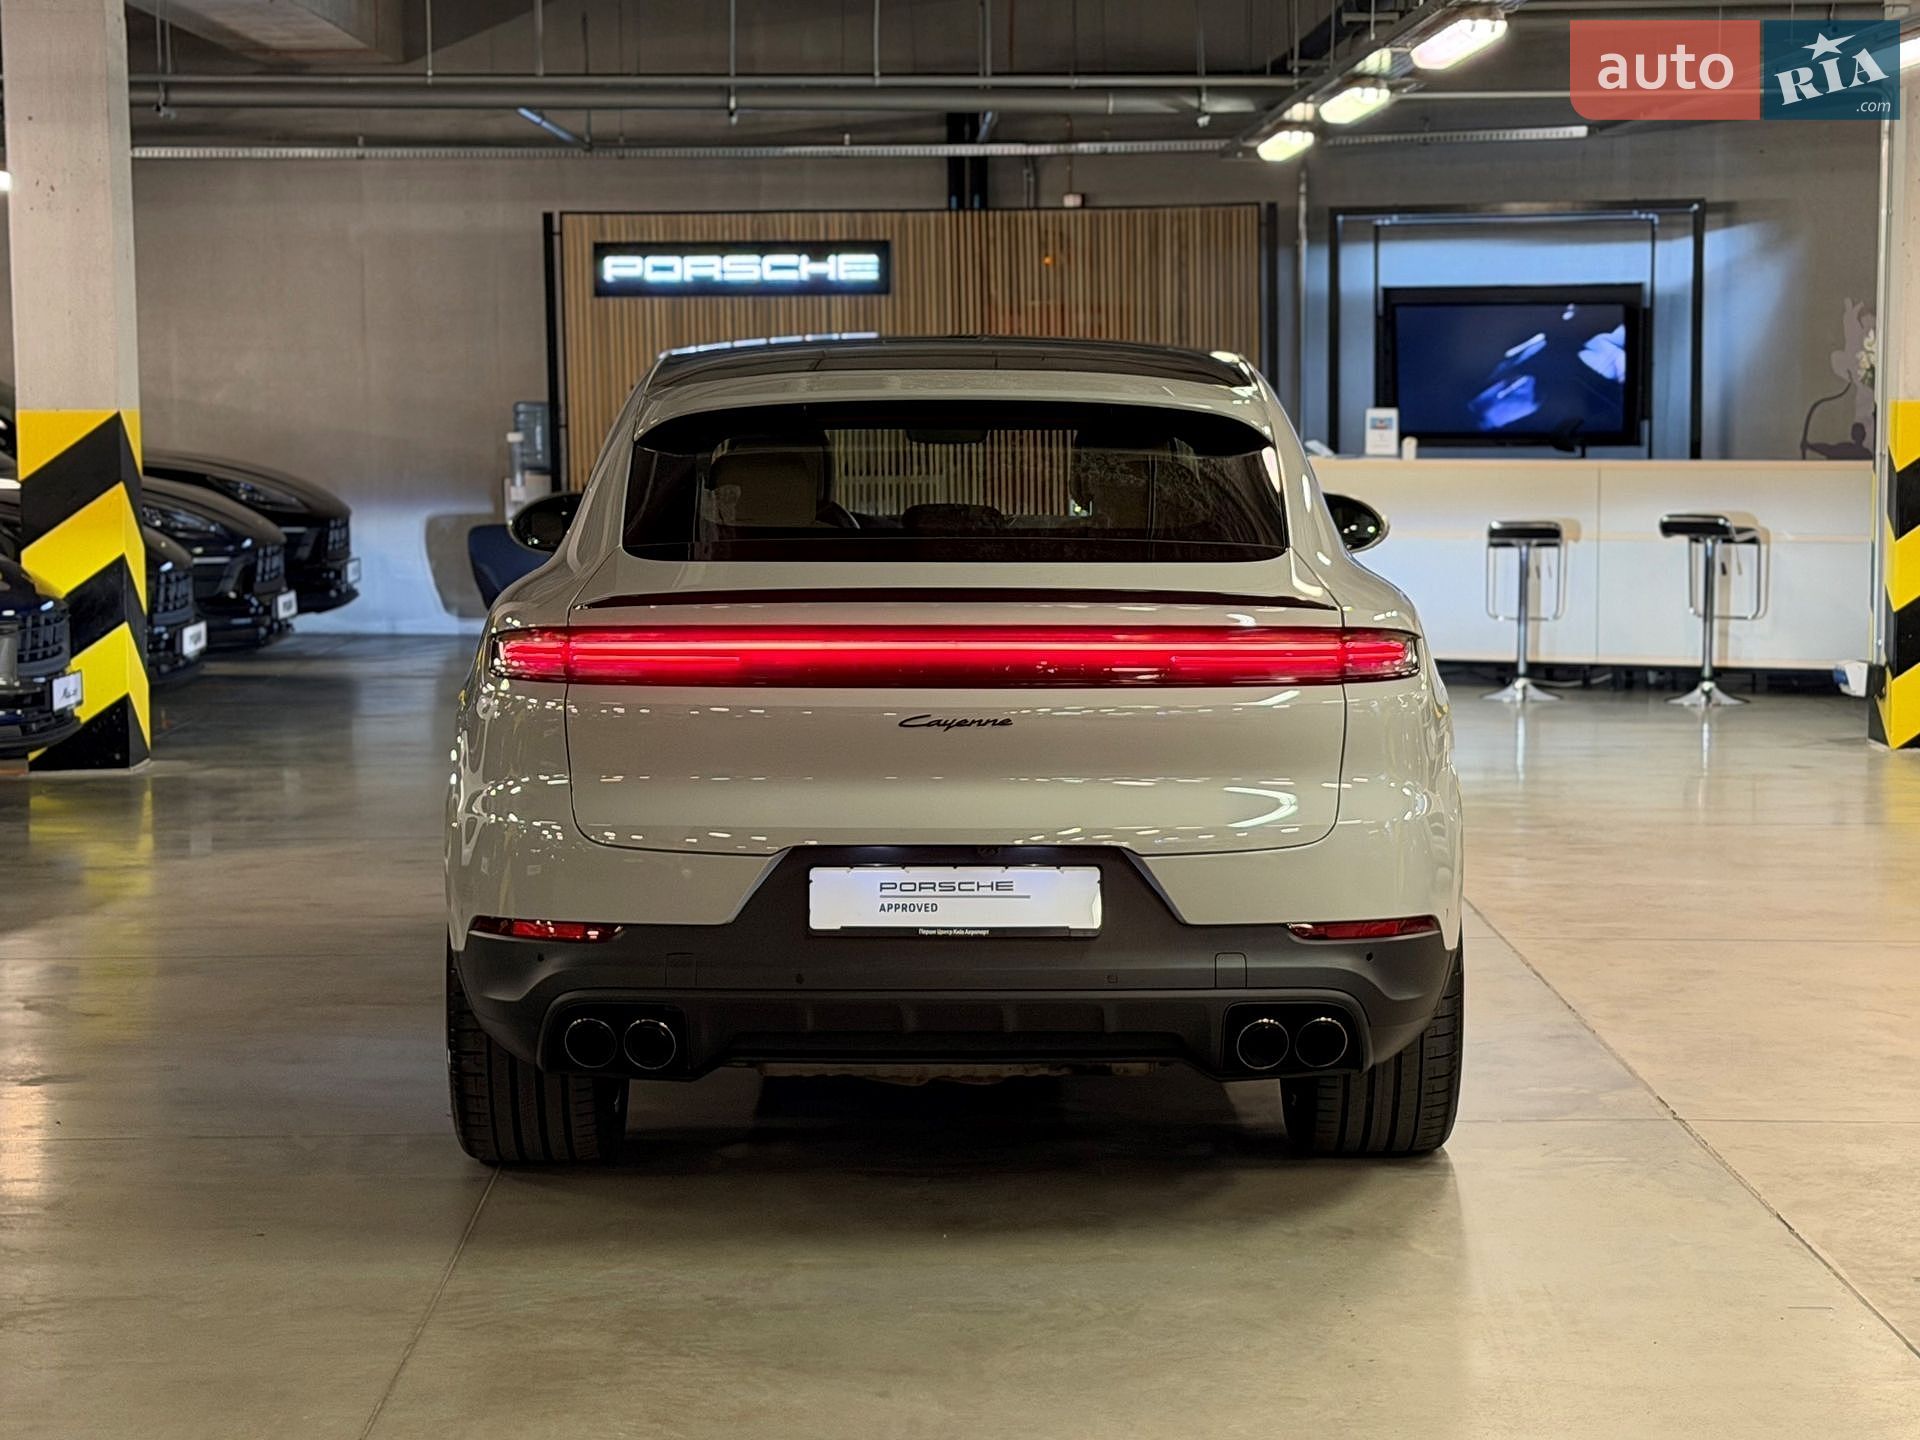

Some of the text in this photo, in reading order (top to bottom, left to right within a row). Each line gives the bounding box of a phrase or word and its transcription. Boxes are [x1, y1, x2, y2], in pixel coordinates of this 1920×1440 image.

[602, 254, 880, 283] PORSCHE
[898, 714, 1013, 732] Cayenne
[879, 880, 1014, 892] PORSCHE
[879, 903, 938, 913] APPROVED
